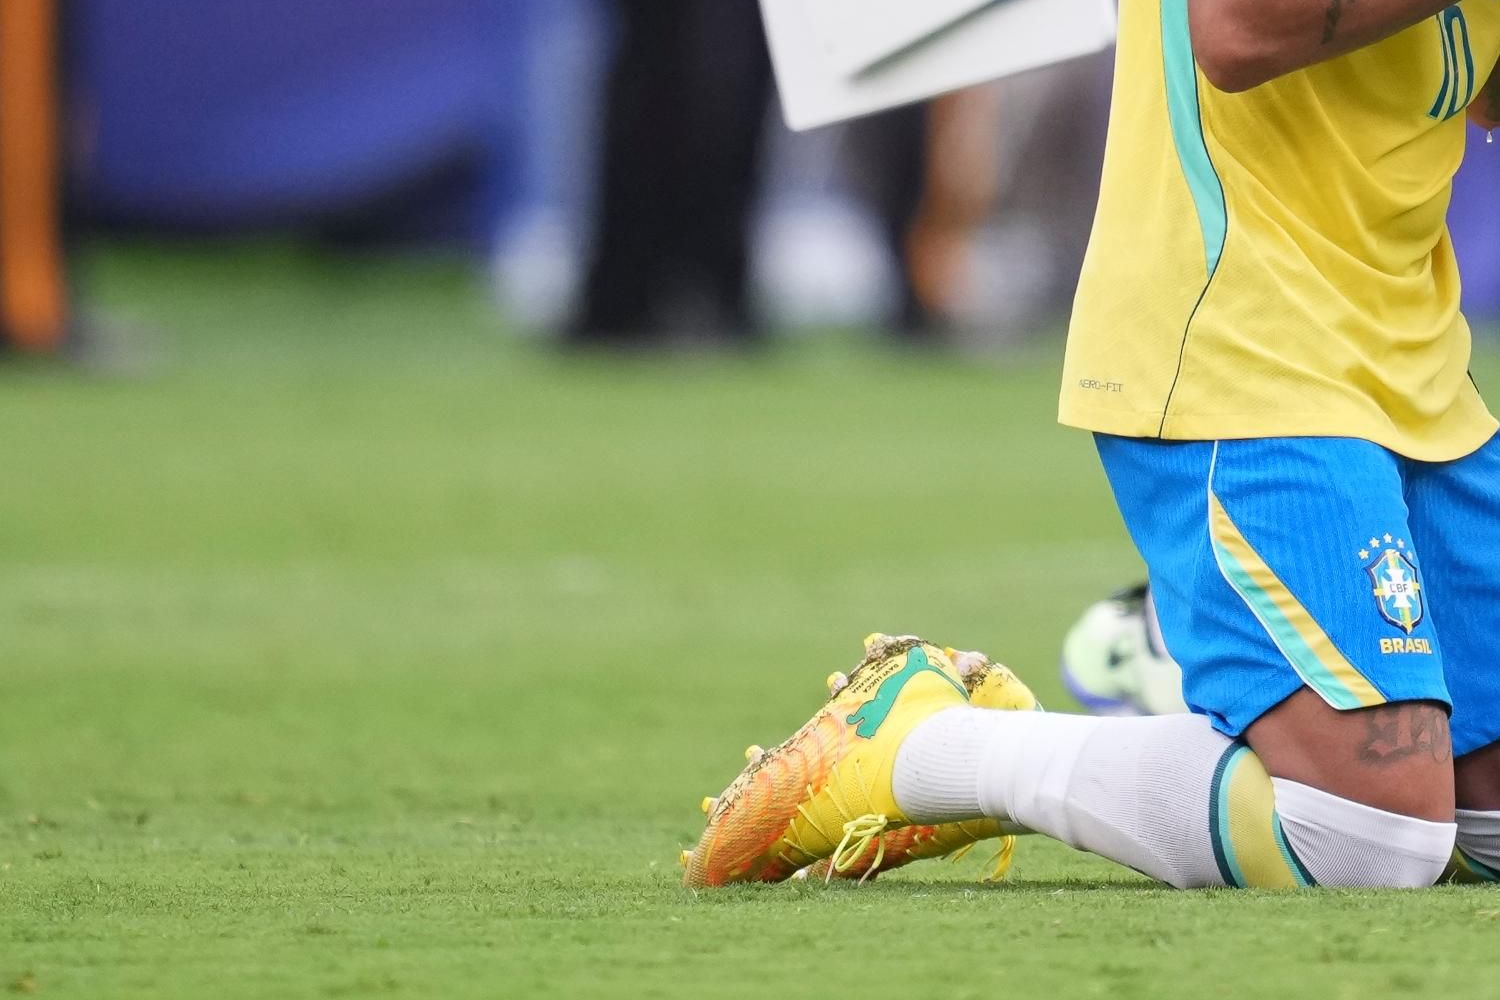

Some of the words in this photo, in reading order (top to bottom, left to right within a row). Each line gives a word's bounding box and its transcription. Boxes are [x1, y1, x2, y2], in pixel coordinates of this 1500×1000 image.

[1426, 4, 1474, 122] 10
[1389, 582, 1410, 594] CBF
[1379, 638, 1433, 655] BRASIL
